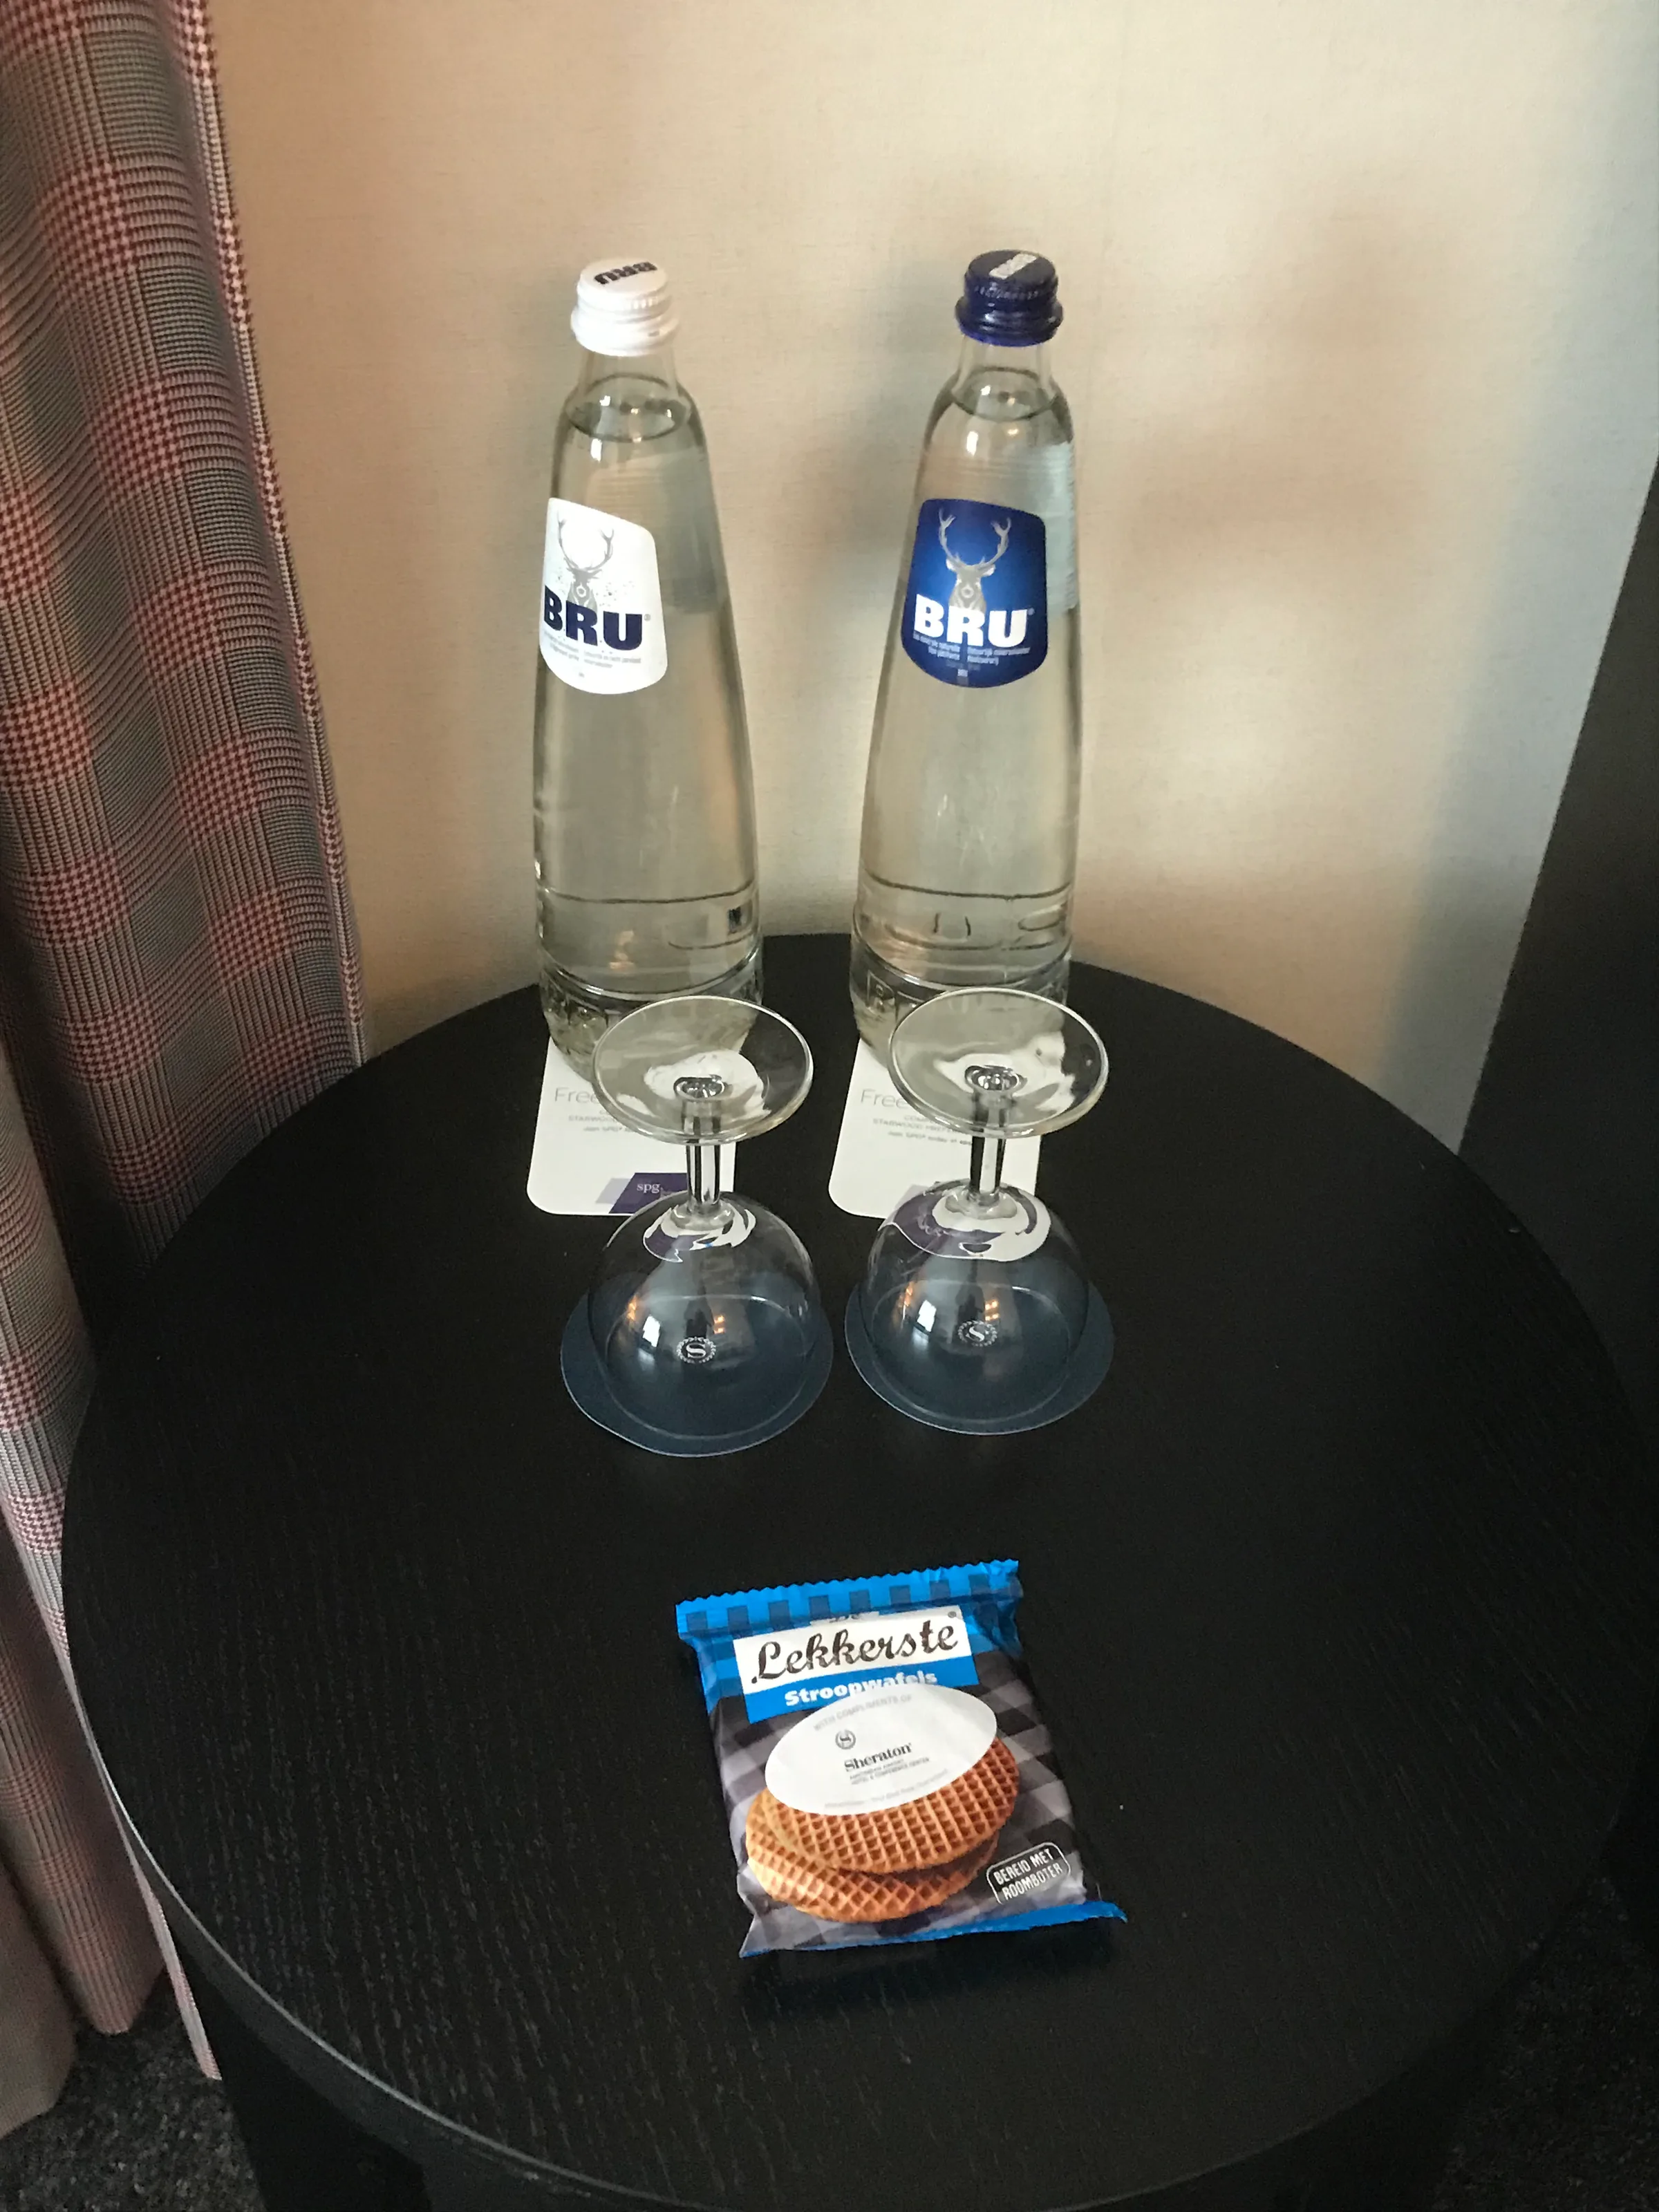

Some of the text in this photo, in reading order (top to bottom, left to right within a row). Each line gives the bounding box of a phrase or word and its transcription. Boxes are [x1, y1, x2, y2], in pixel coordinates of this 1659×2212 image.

[544, 585, 643, 651] BRU
[914, 594, 1028, 648] BRU
[751, 1620, 959, 1685] Lekkerste
[844, 1743, 912, 1772] Sheraton
[993, 1848, 1053, 1886] BEREID MET
[1002, 1862, 1063, 1901] ROOMBOTER
